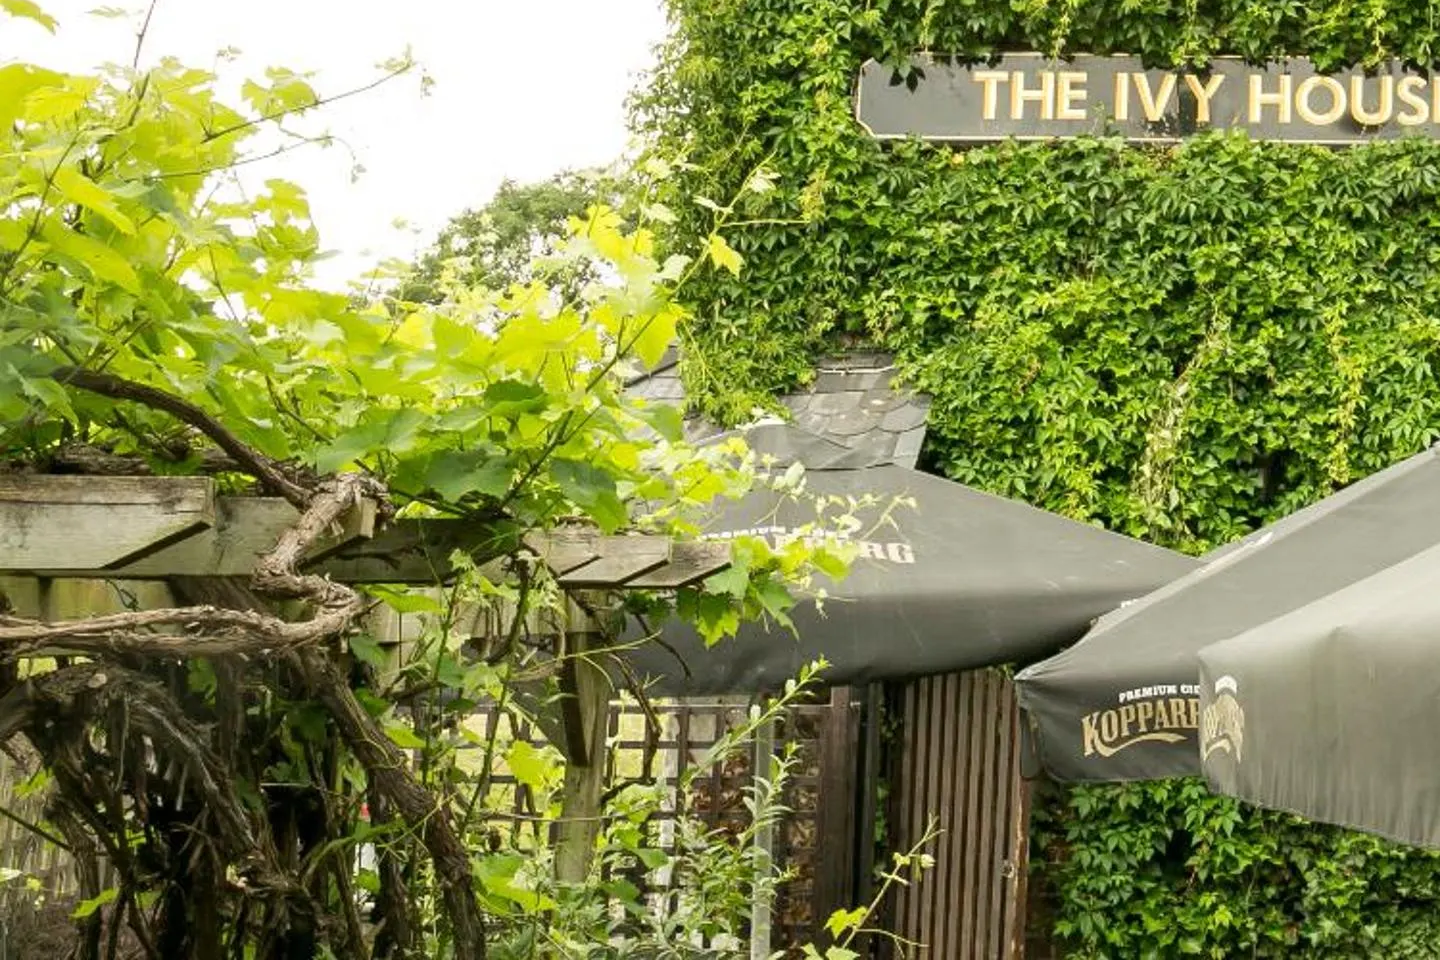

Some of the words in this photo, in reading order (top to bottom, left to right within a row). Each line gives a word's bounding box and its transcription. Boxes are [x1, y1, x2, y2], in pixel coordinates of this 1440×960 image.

[972, 70, 1088, 121] THE
[1114, 71, 1223, 124] IVY
[1118, 684, 1178, 703] PREMIUM
[1081, 698, 1200, 757] KOPPARB
